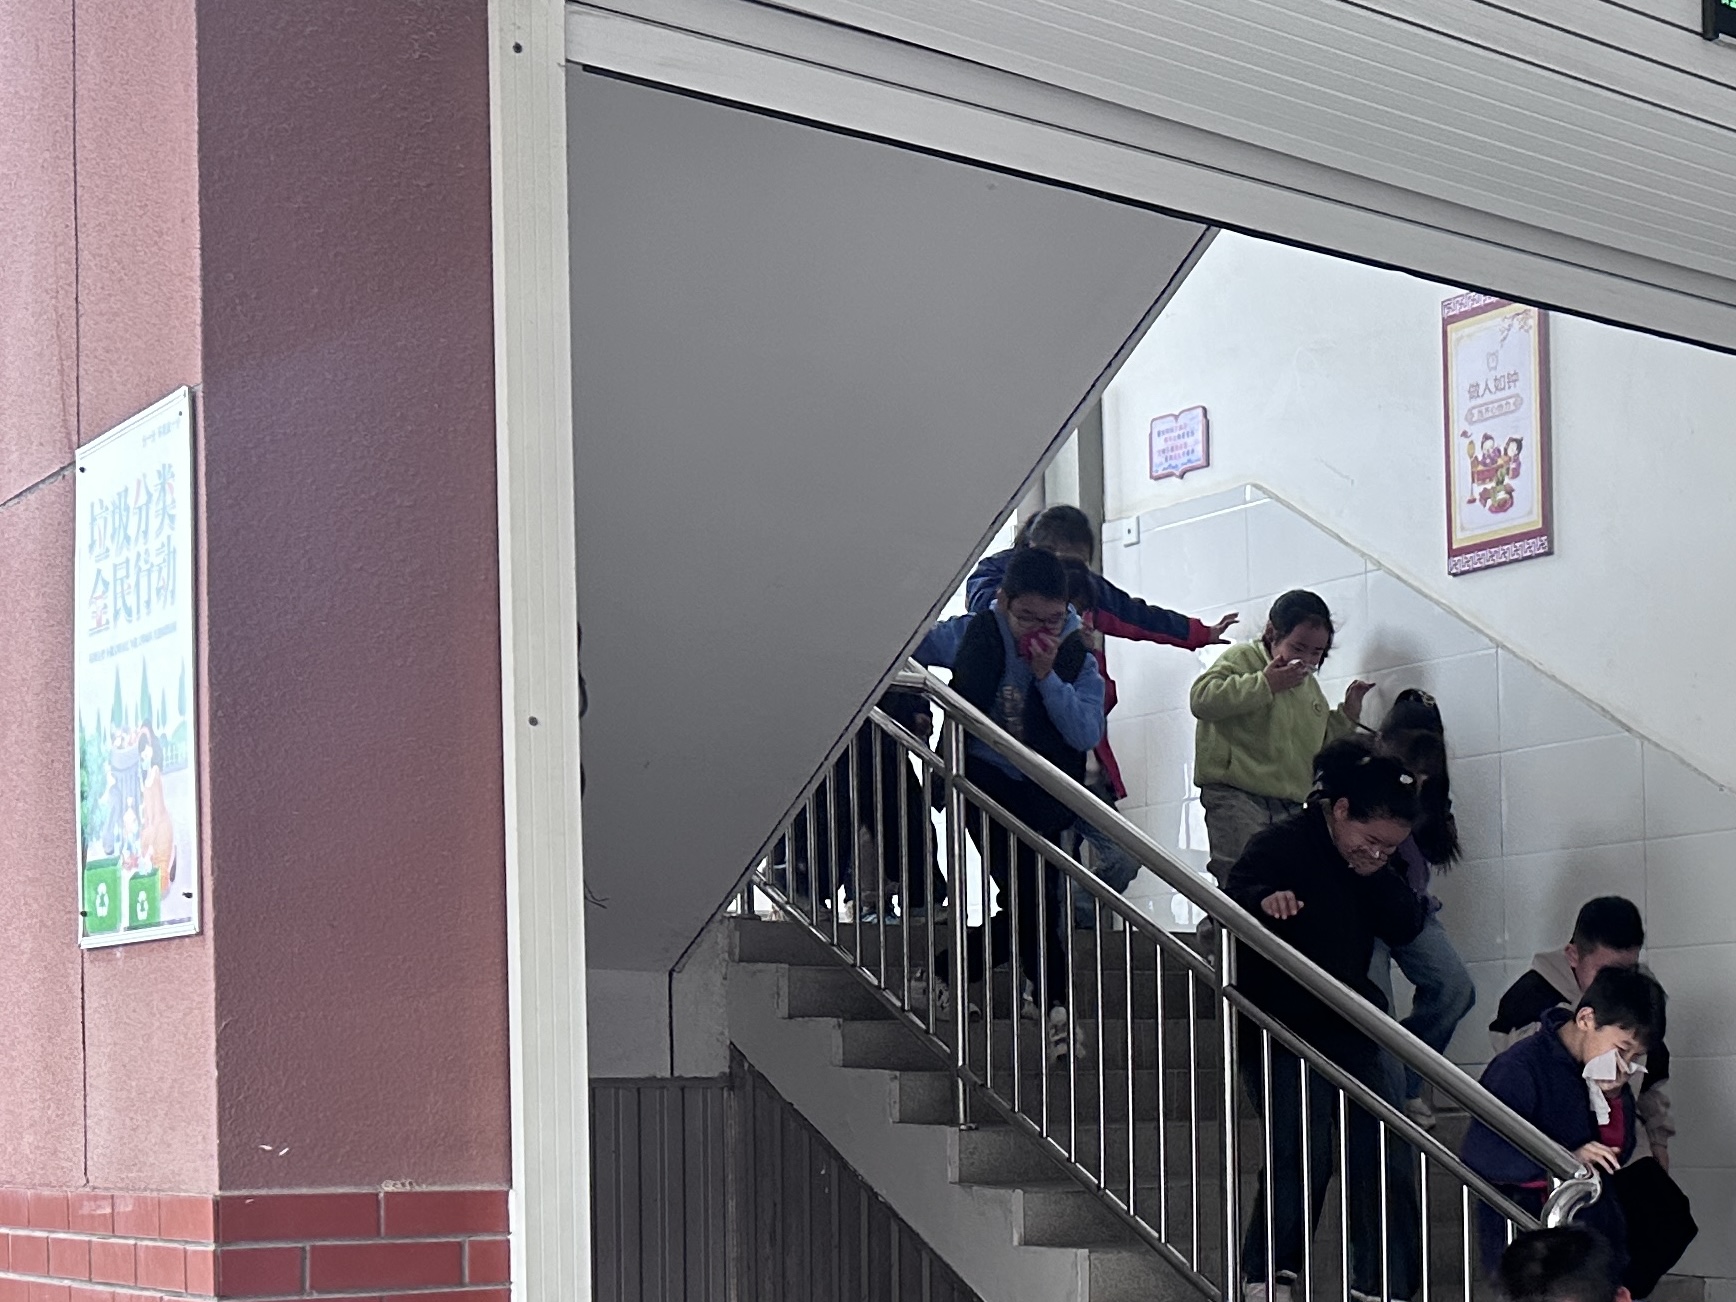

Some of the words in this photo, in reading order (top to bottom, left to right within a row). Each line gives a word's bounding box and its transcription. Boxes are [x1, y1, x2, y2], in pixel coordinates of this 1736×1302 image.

[1467, 370, 1519, 401] 做人如钟
[88, 463, 177, 563] 垃圾分类
[88, 535, 177, 636] 全民行动
